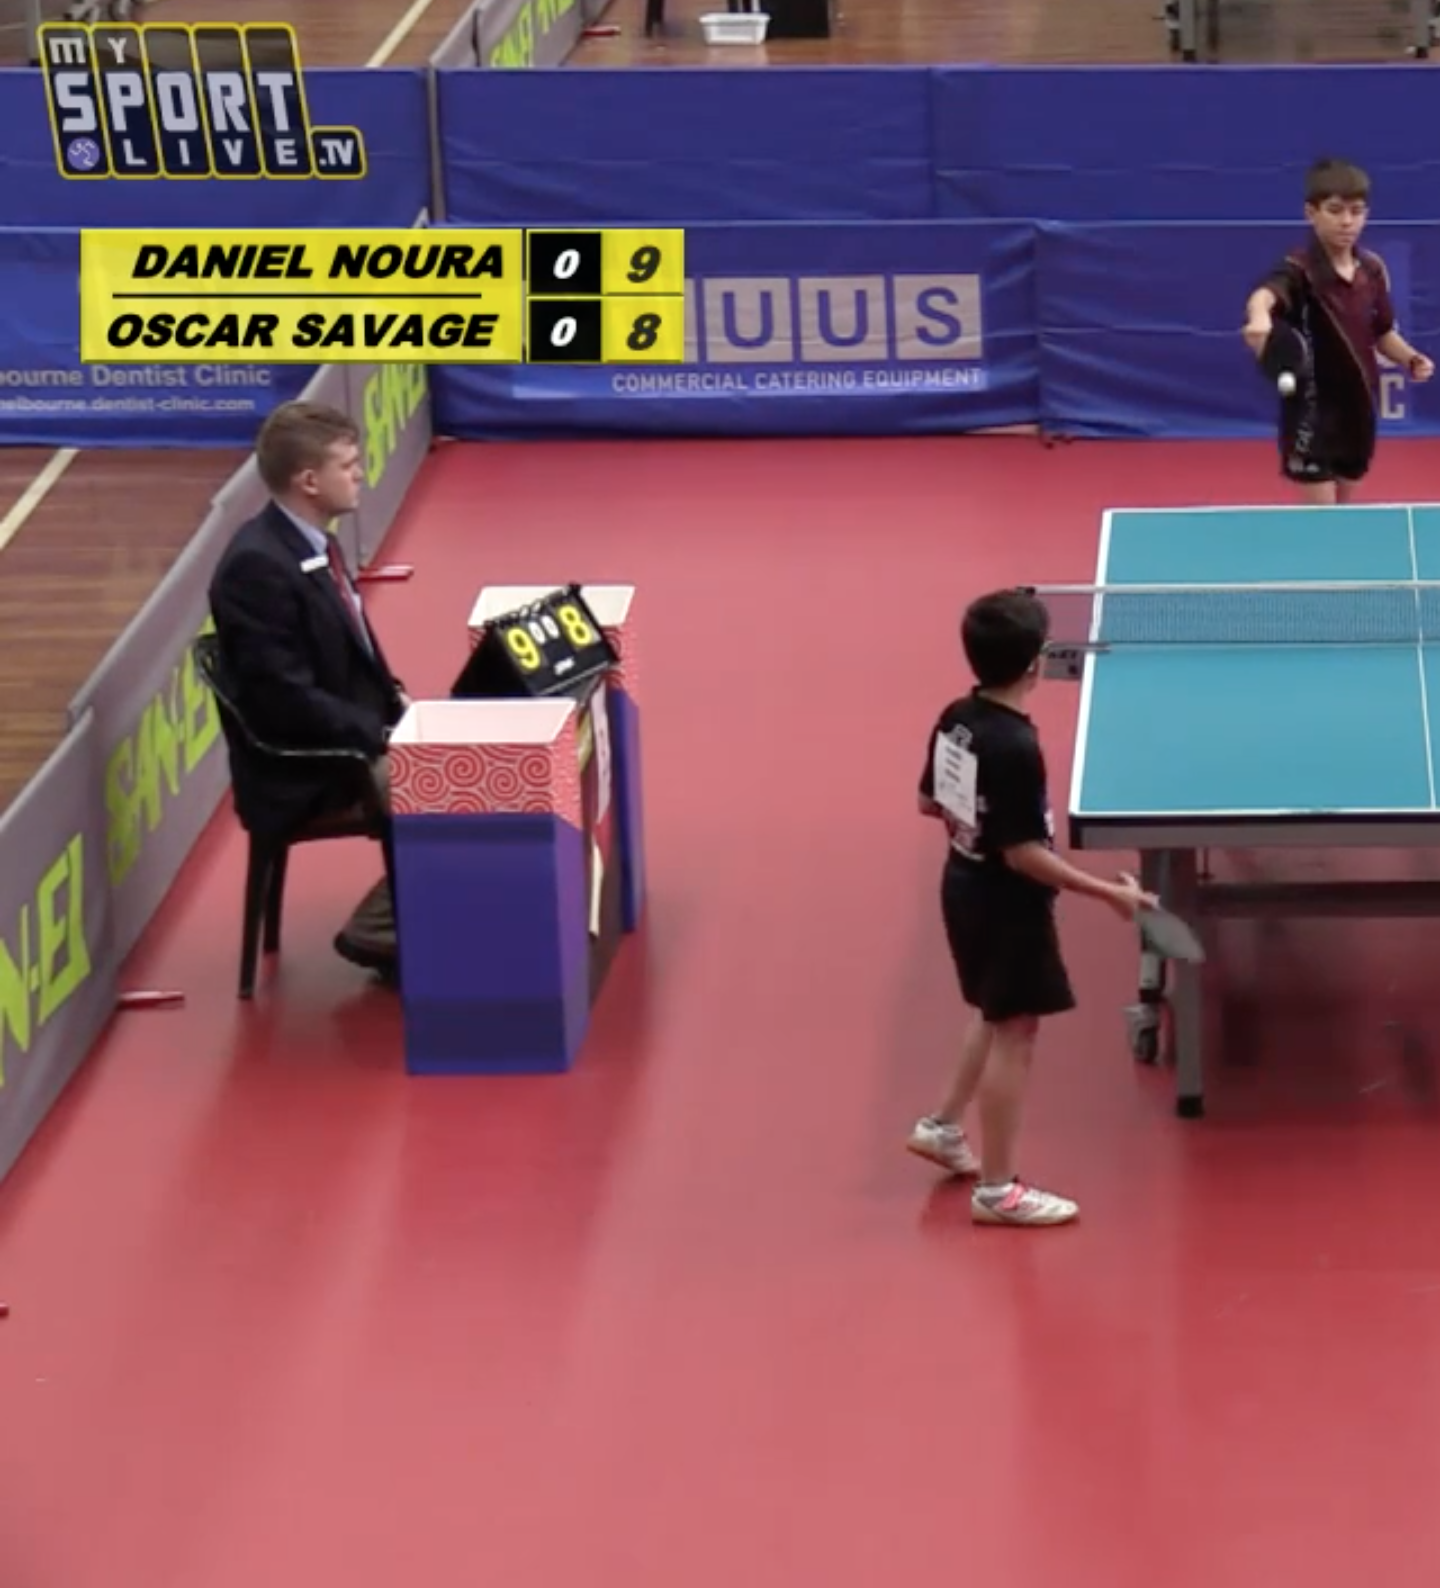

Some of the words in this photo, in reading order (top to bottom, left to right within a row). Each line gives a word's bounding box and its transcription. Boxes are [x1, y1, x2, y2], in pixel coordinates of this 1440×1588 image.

[720, 286, 963, 348] UUS
[92, 365, 187, 386] Dentist
[195, 364, 271, 386] Clinic
[612, 373, 748, 391] COMMERCIAL
[755, 371, 856, 390] CATERING
[863, 368, 981, 388] EQUIPMENT
[507, 627, 541, 670] 9
[557, 604, 593, 646] 8
